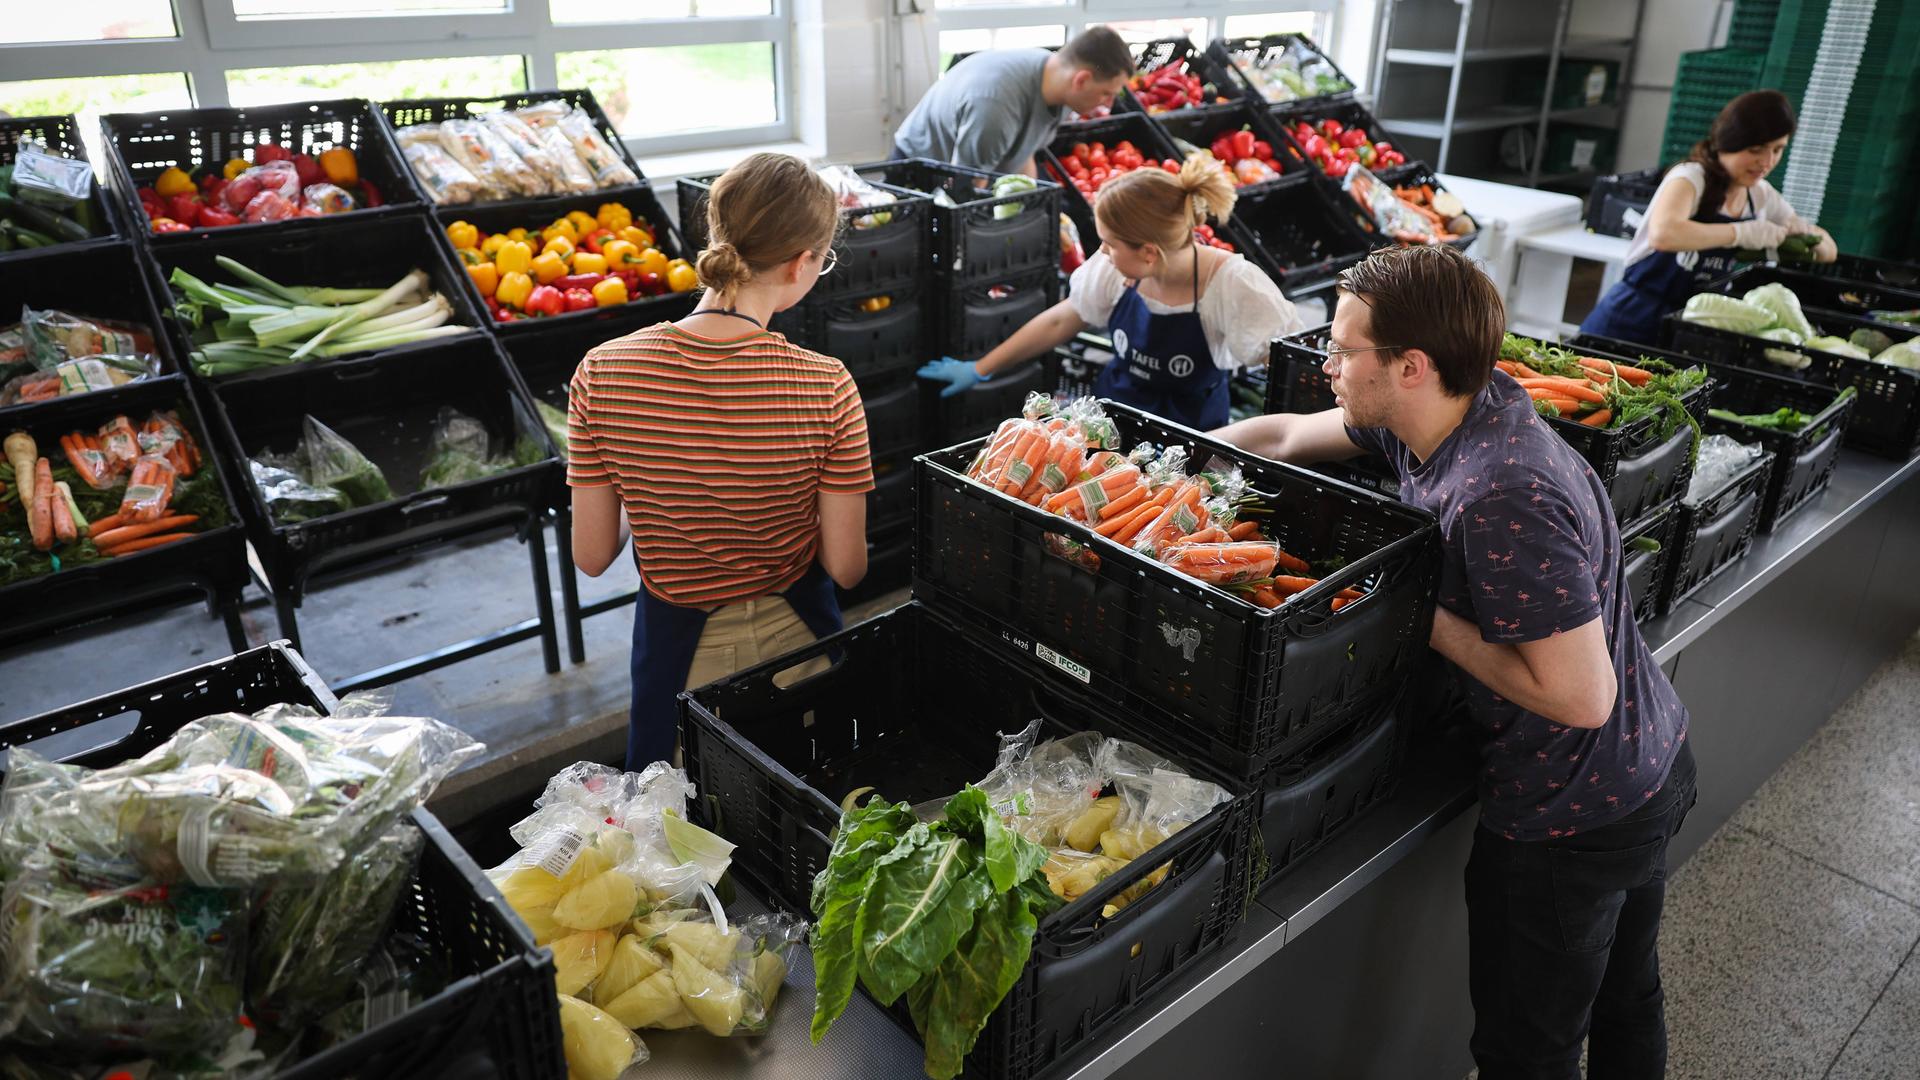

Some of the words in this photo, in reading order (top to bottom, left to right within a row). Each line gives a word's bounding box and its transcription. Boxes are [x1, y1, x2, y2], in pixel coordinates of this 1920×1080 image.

[1131, 348, 1161, 370] TAFEL
[1002, 631, 1010, 640] LL
[1013, 637, 1028, 650] 6420
[1059, 656, 1079, 673] IFCO
[85, 918, 165, 950] Salate
